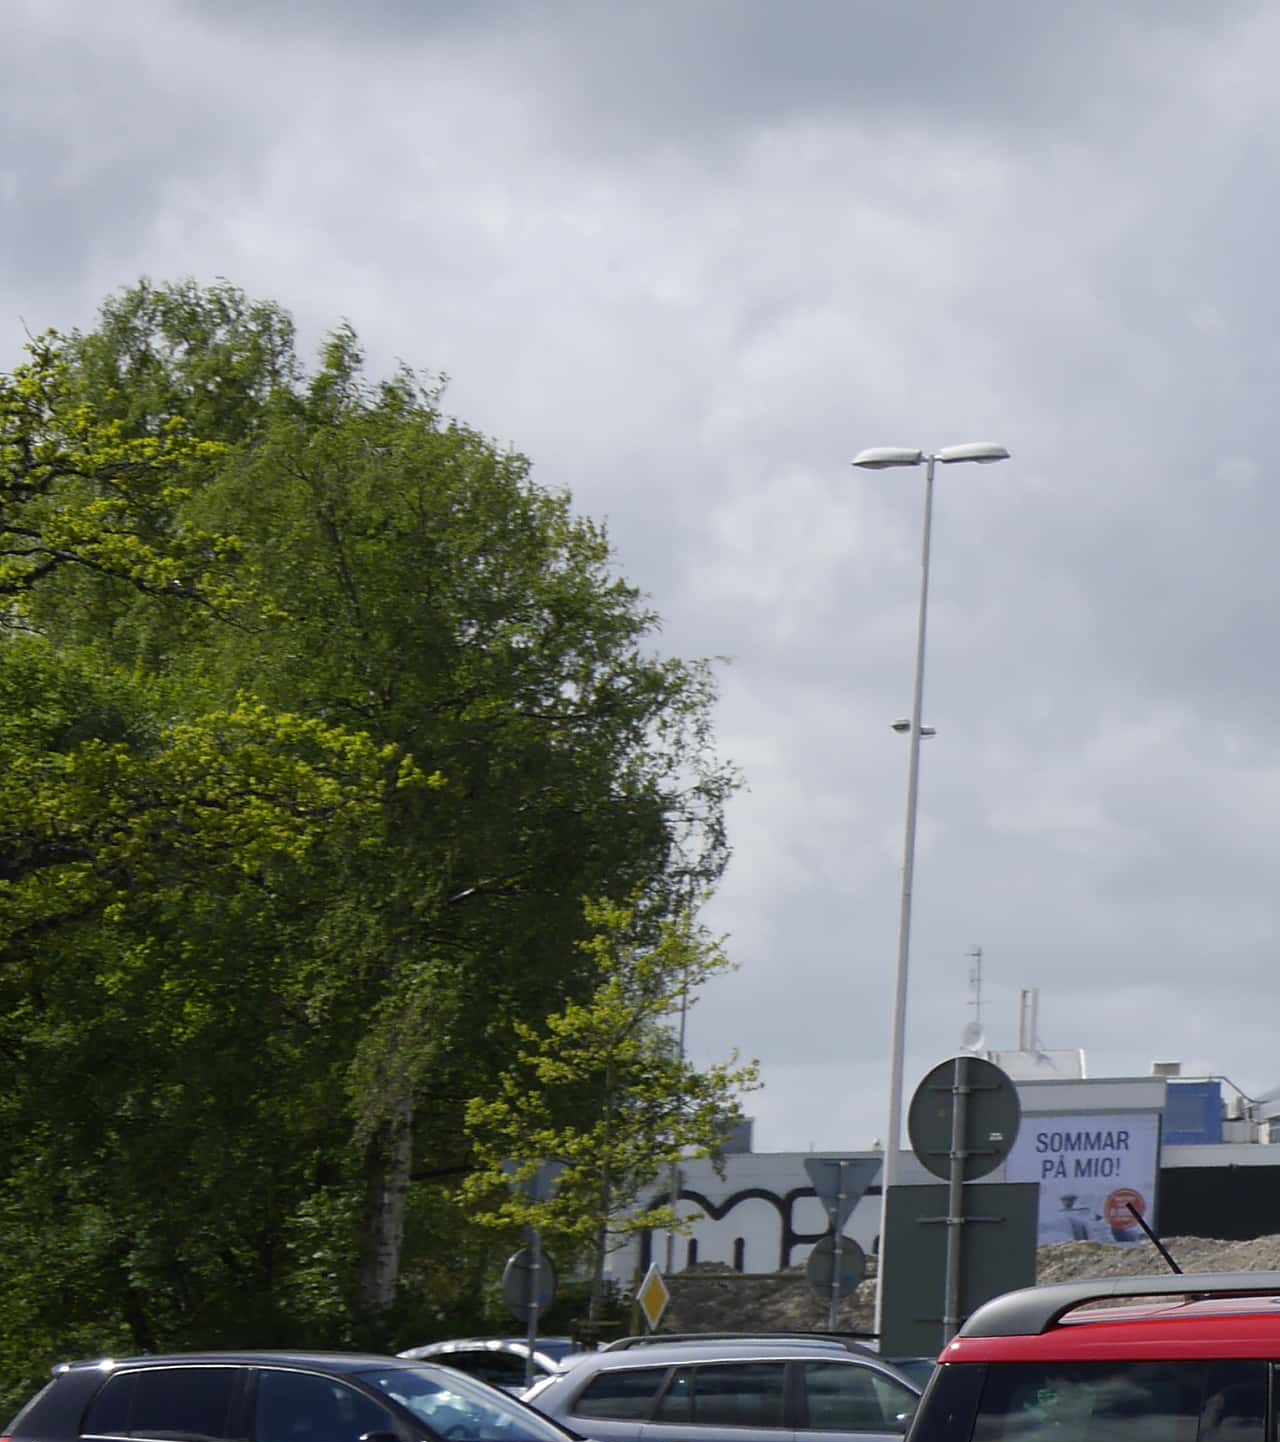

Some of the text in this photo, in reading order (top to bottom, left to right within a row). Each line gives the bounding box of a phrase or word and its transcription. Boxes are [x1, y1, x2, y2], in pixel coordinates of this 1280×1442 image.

[1035, 1130, 1130, 1153] SOMMAR
[1041, 1155, 1121, 1179] PÅ MIO!
